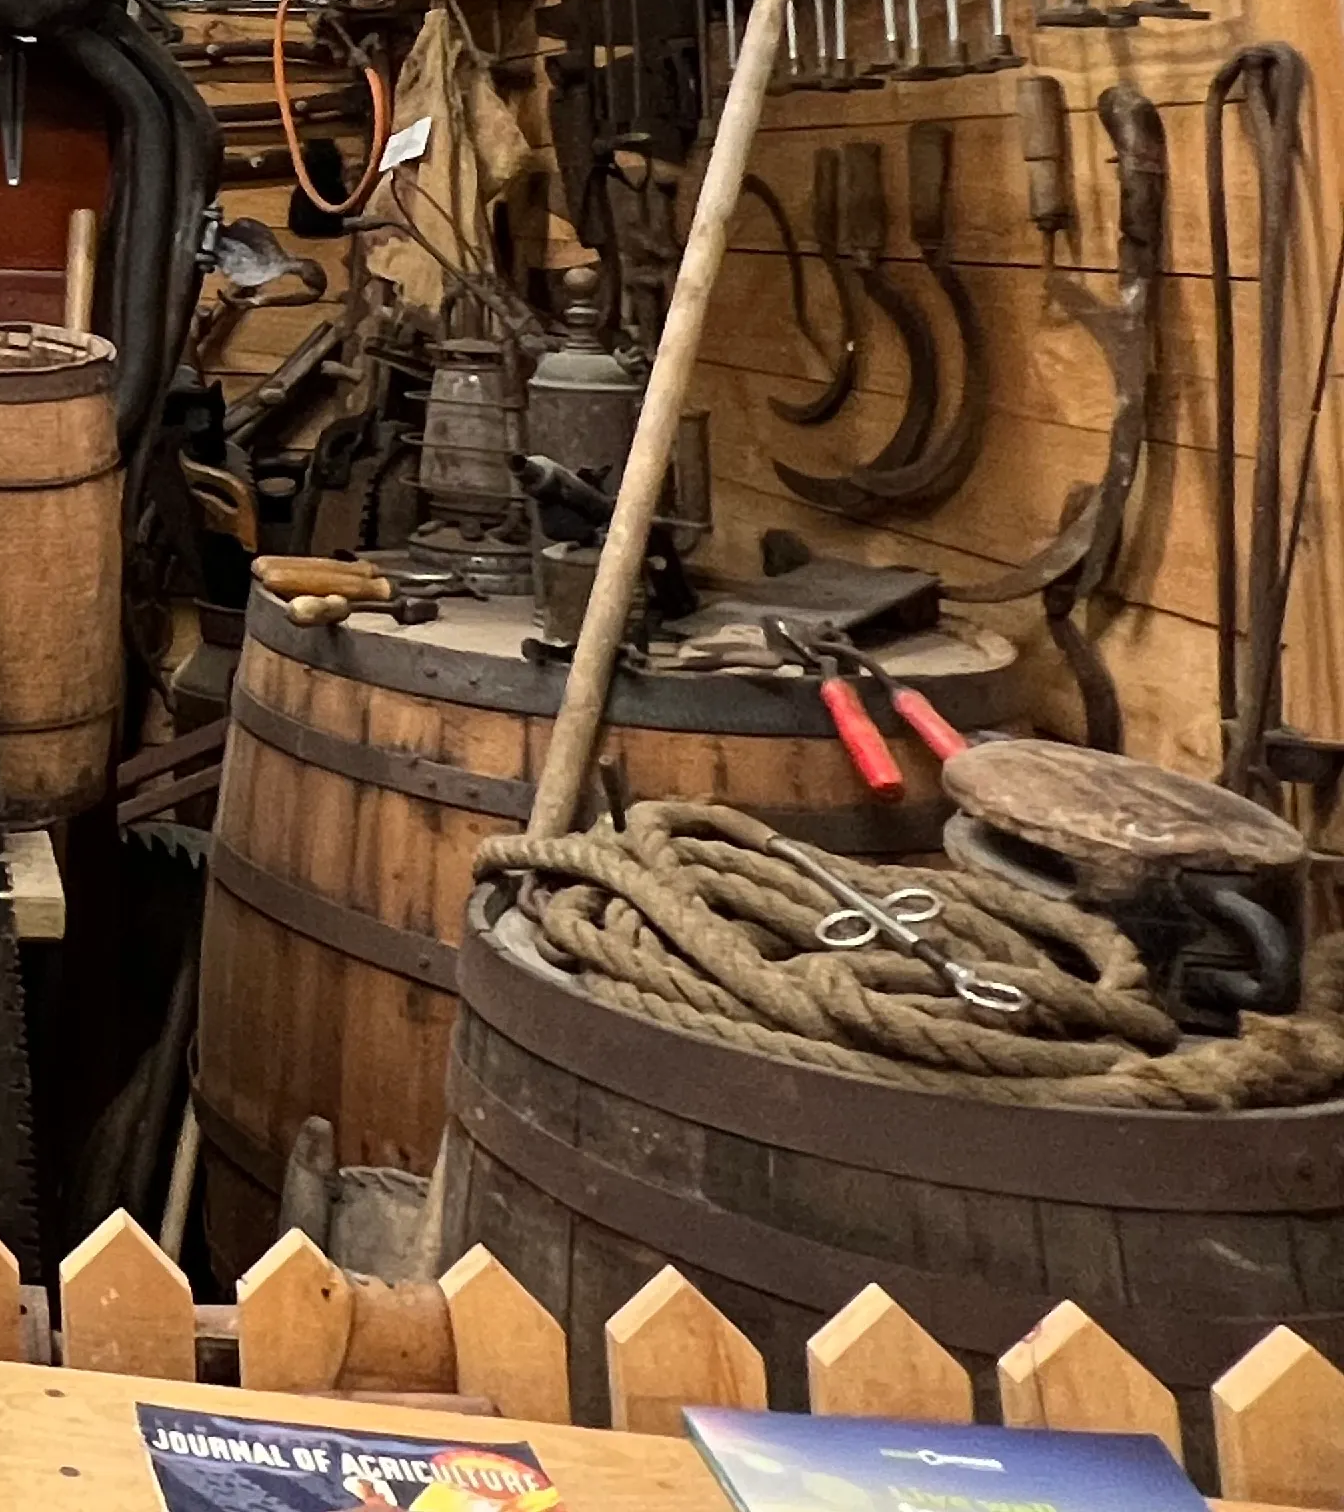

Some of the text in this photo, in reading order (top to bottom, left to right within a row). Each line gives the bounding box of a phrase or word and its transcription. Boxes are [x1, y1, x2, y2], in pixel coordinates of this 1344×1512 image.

[152, 1427, 541, 1495] JOURNAL OF AGRICULTURE
